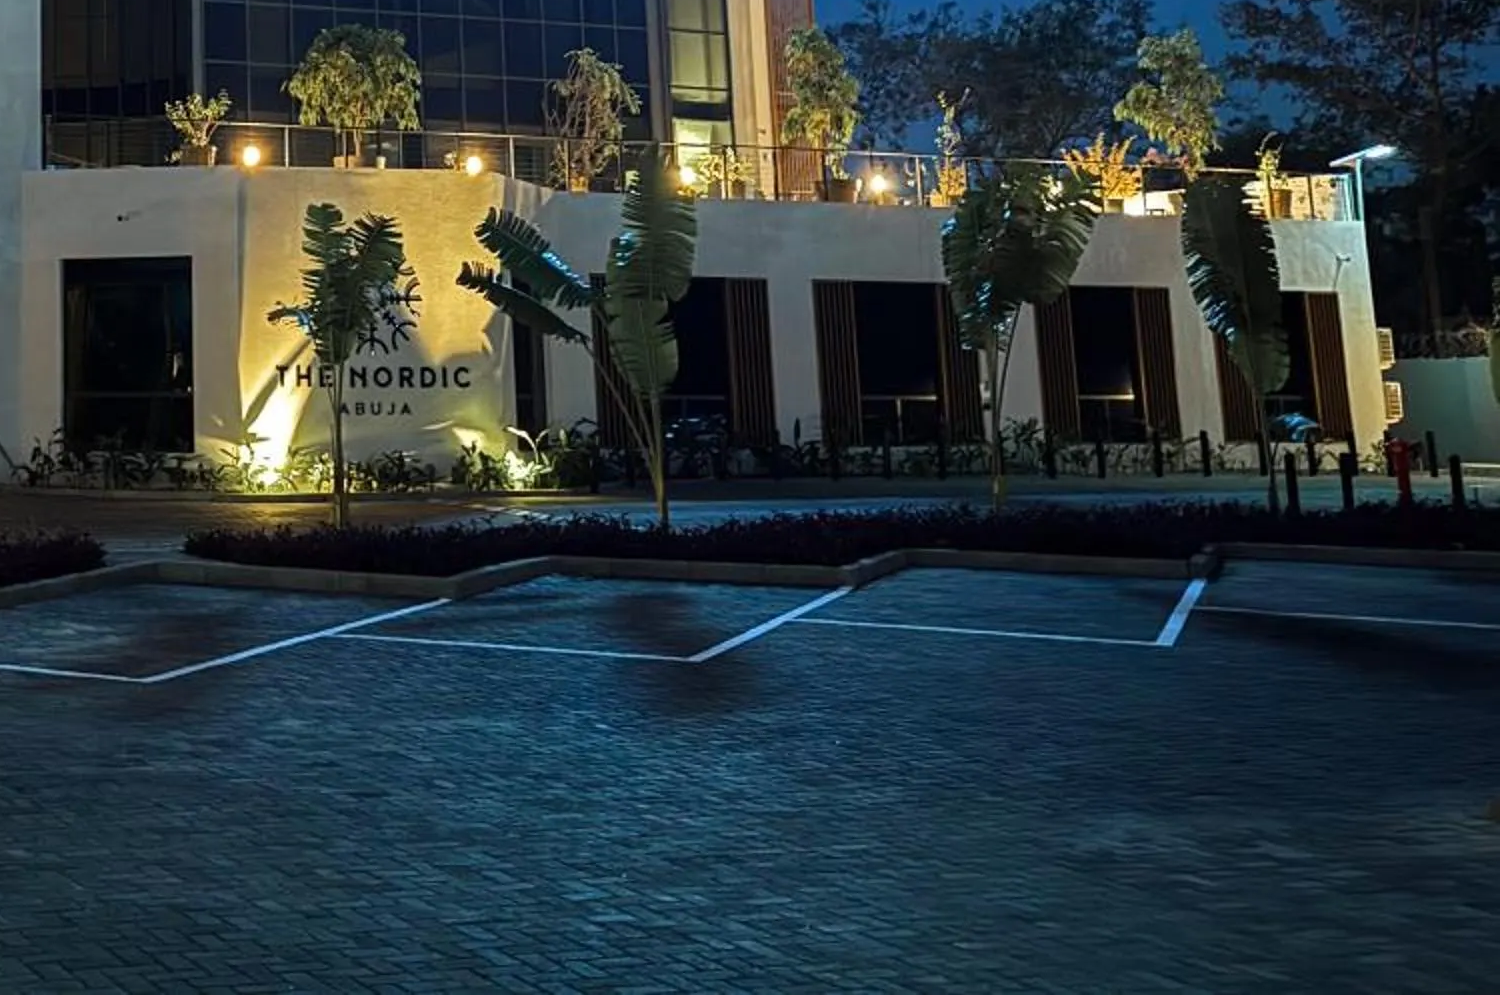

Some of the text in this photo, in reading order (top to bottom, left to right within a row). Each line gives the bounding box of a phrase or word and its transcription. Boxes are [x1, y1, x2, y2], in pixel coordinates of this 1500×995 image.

[276, 365, 471, 388] THE NORDIC
[340, 402, 412, 416] ABUJA
